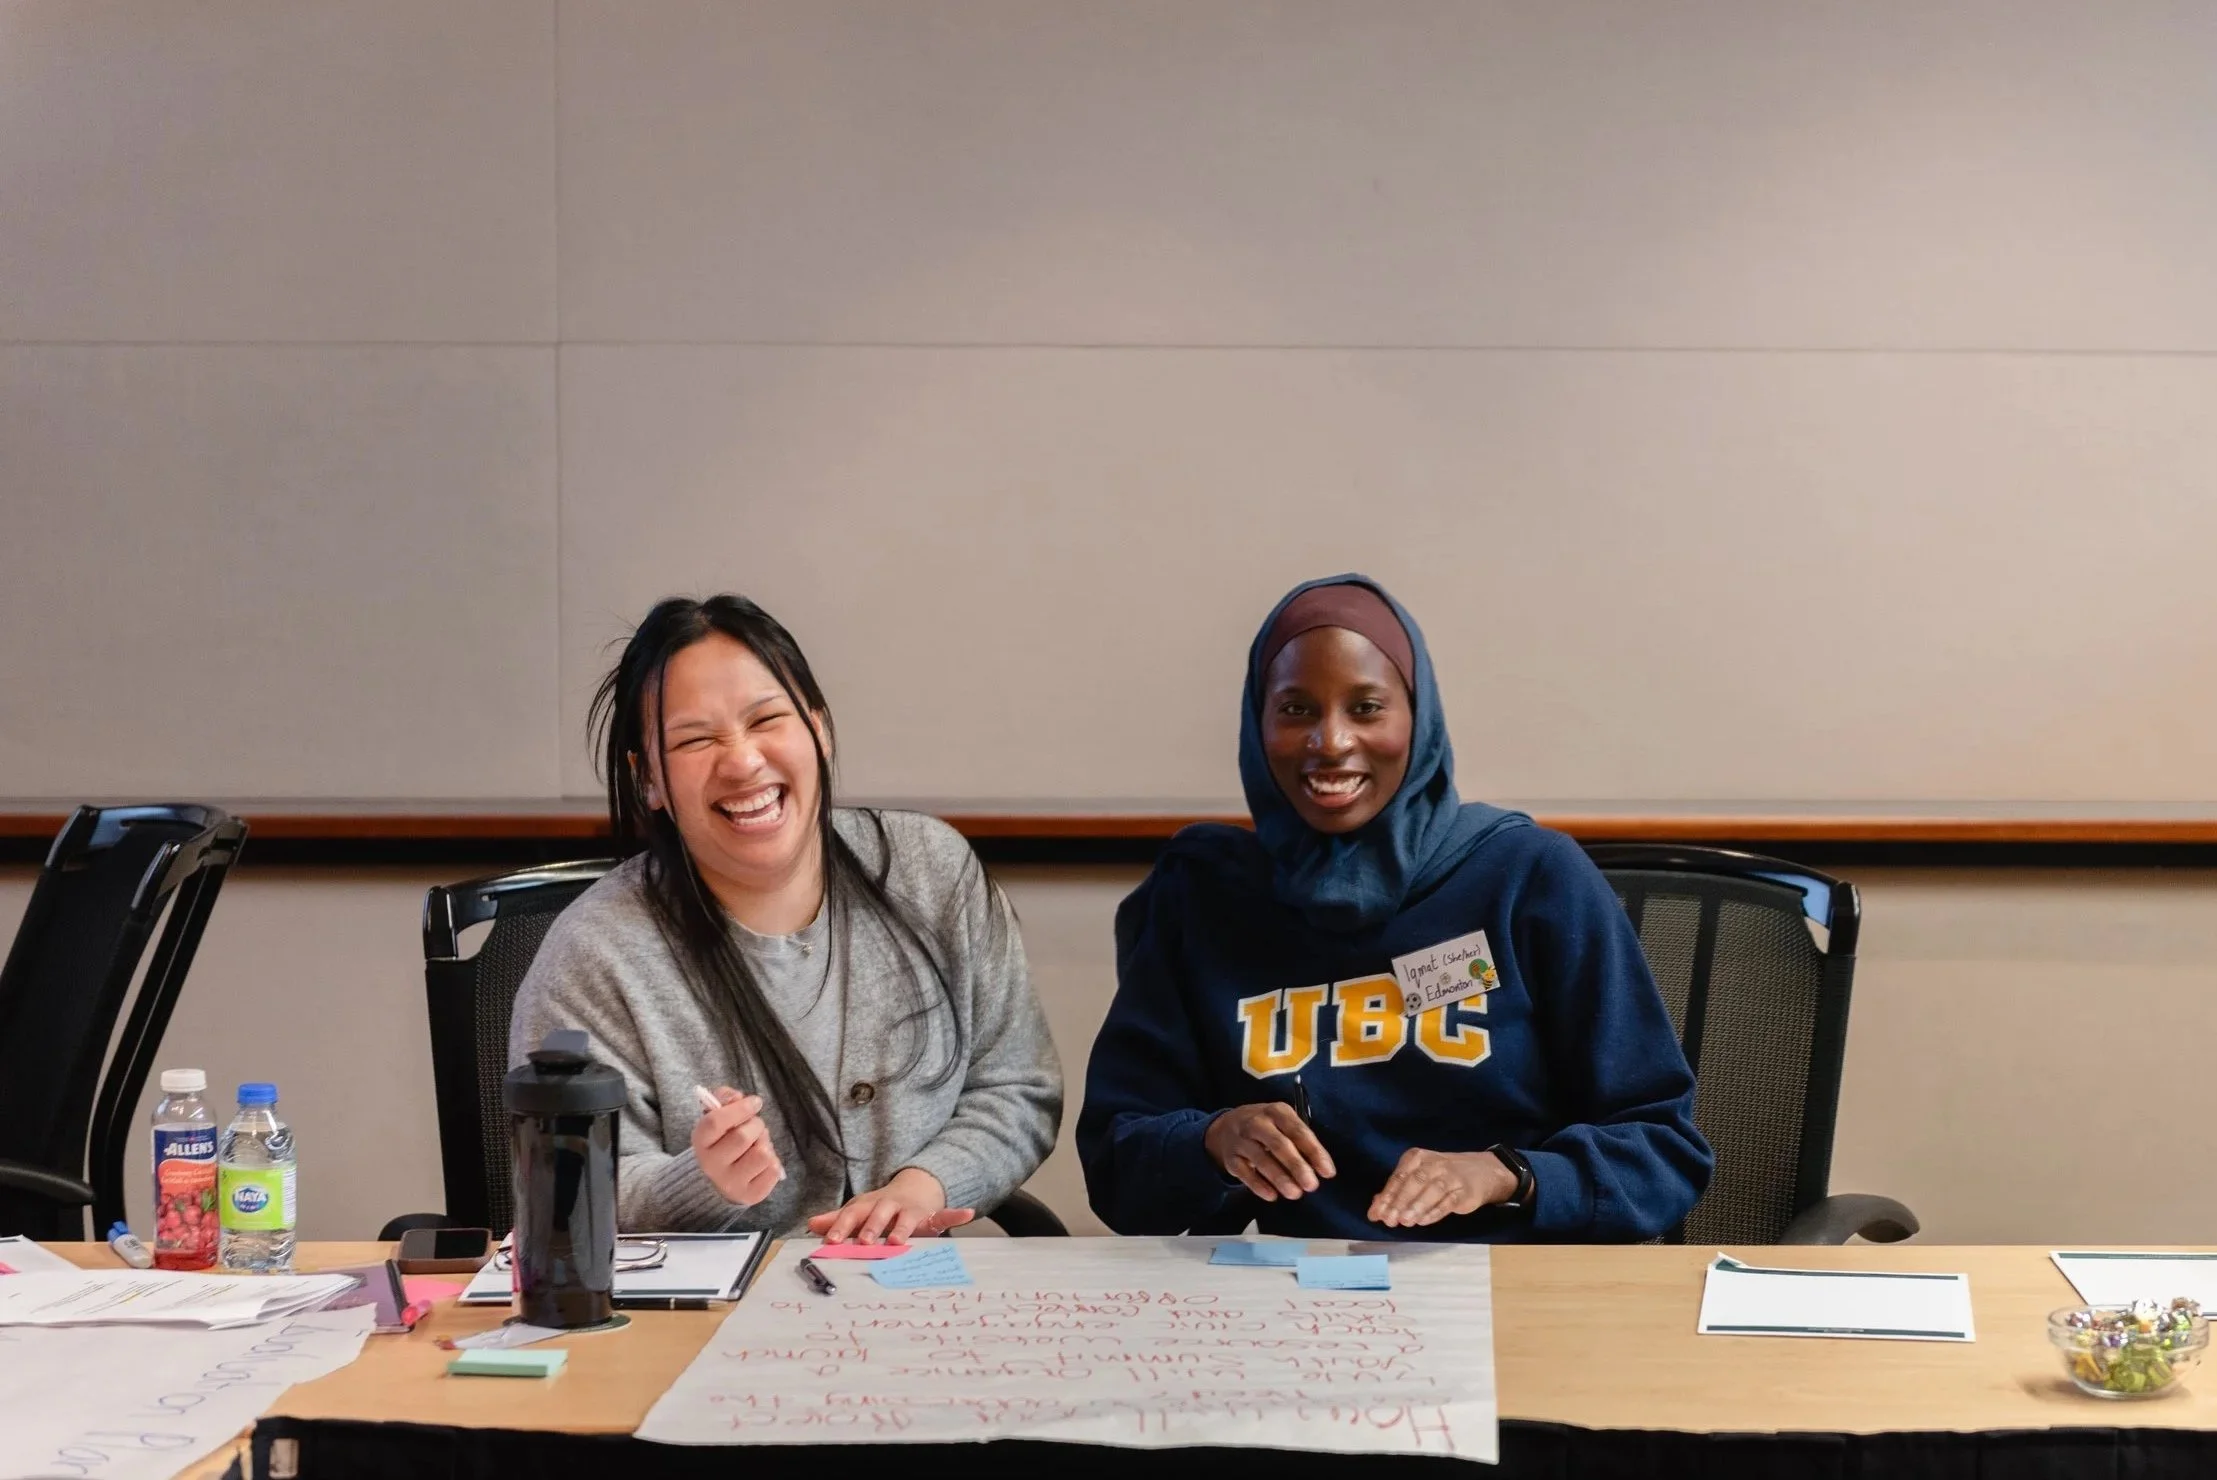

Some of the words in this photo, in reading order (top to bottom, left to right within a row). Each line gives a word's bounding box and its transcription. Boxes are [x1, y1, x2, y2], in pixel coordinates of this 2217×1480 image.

[1426, 979, 1473, 1001] Edmonton
[1237, 972, 1492, 1080] UBC
[770, 1301, 811, 1315] to
[842, 1301, 970, 1315] them
[1284, 1299, 1397, 1314] local
[818, 1313, 1121, 1330] engagement
[1168, 1309, 1245, 1320] and
[1149, 1320, 1266, 1332] civic
[1294, 1322, 1424, 1340] teach
[805, 1331, 864, 1346] to
[722, 1348, 867, 1363] launch
[928, 1348, 990, 1364] to
[806, 1365, 840, 1378] a
